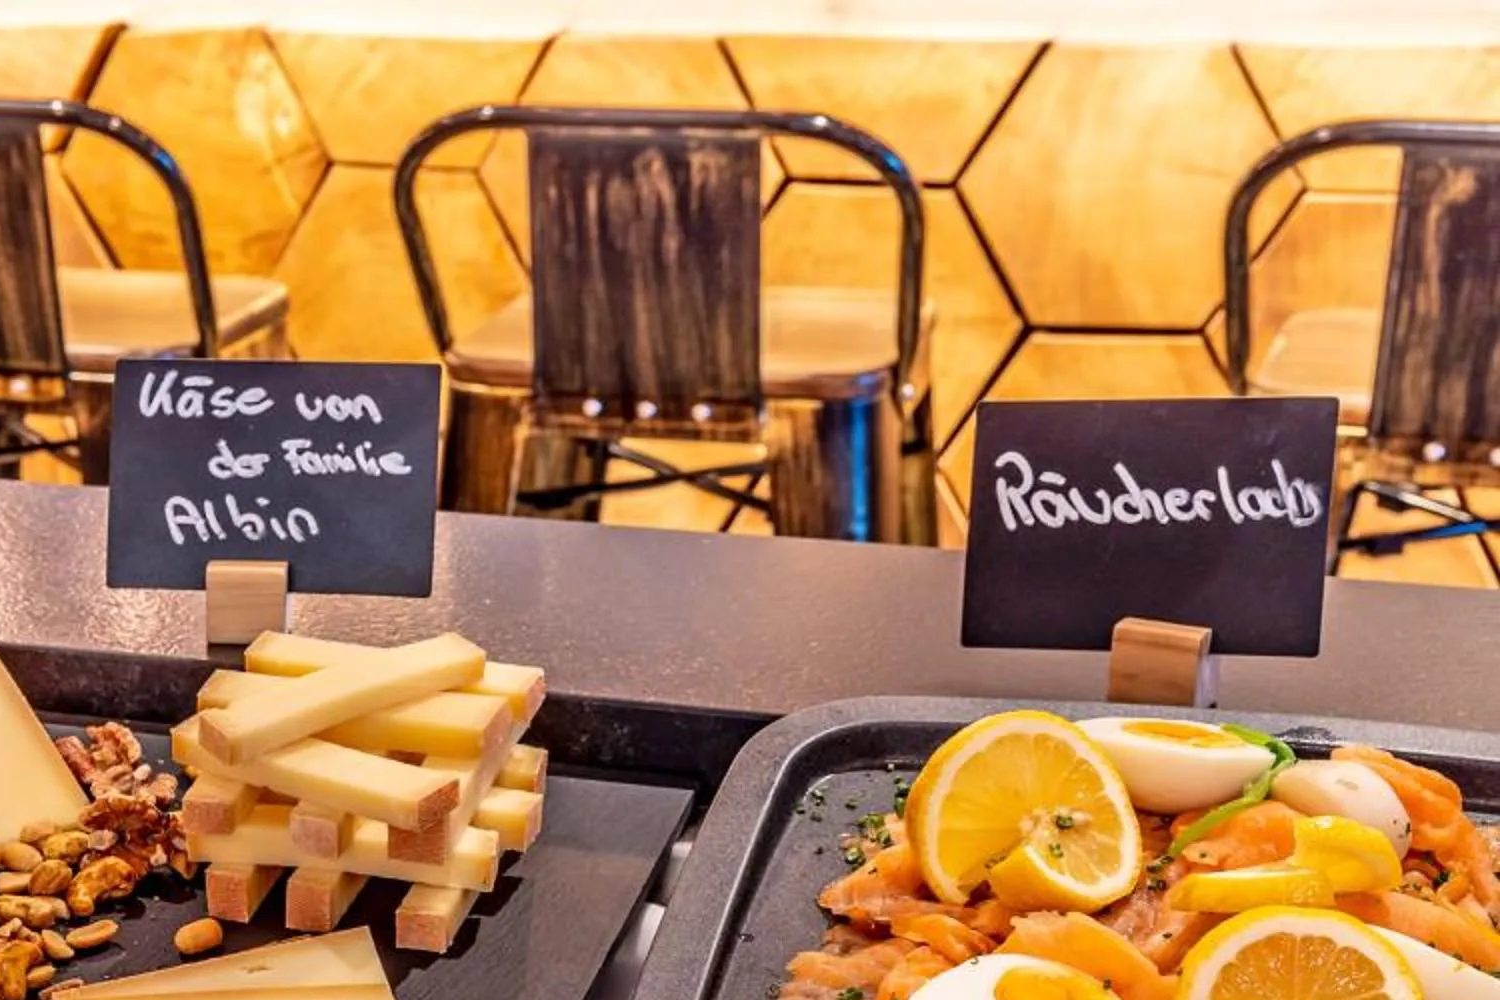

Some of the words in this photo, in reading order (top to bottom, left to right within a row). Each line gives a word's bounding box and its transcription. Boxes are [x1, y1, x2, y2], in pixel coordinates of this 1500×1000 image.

[138, 368, 275, 419] Käse
[294, 391, 384, 425] von
[206, 437, 272, 480] der
[280, 438, 413, 477] Familie
[163, 492, 321, 546] Albin
